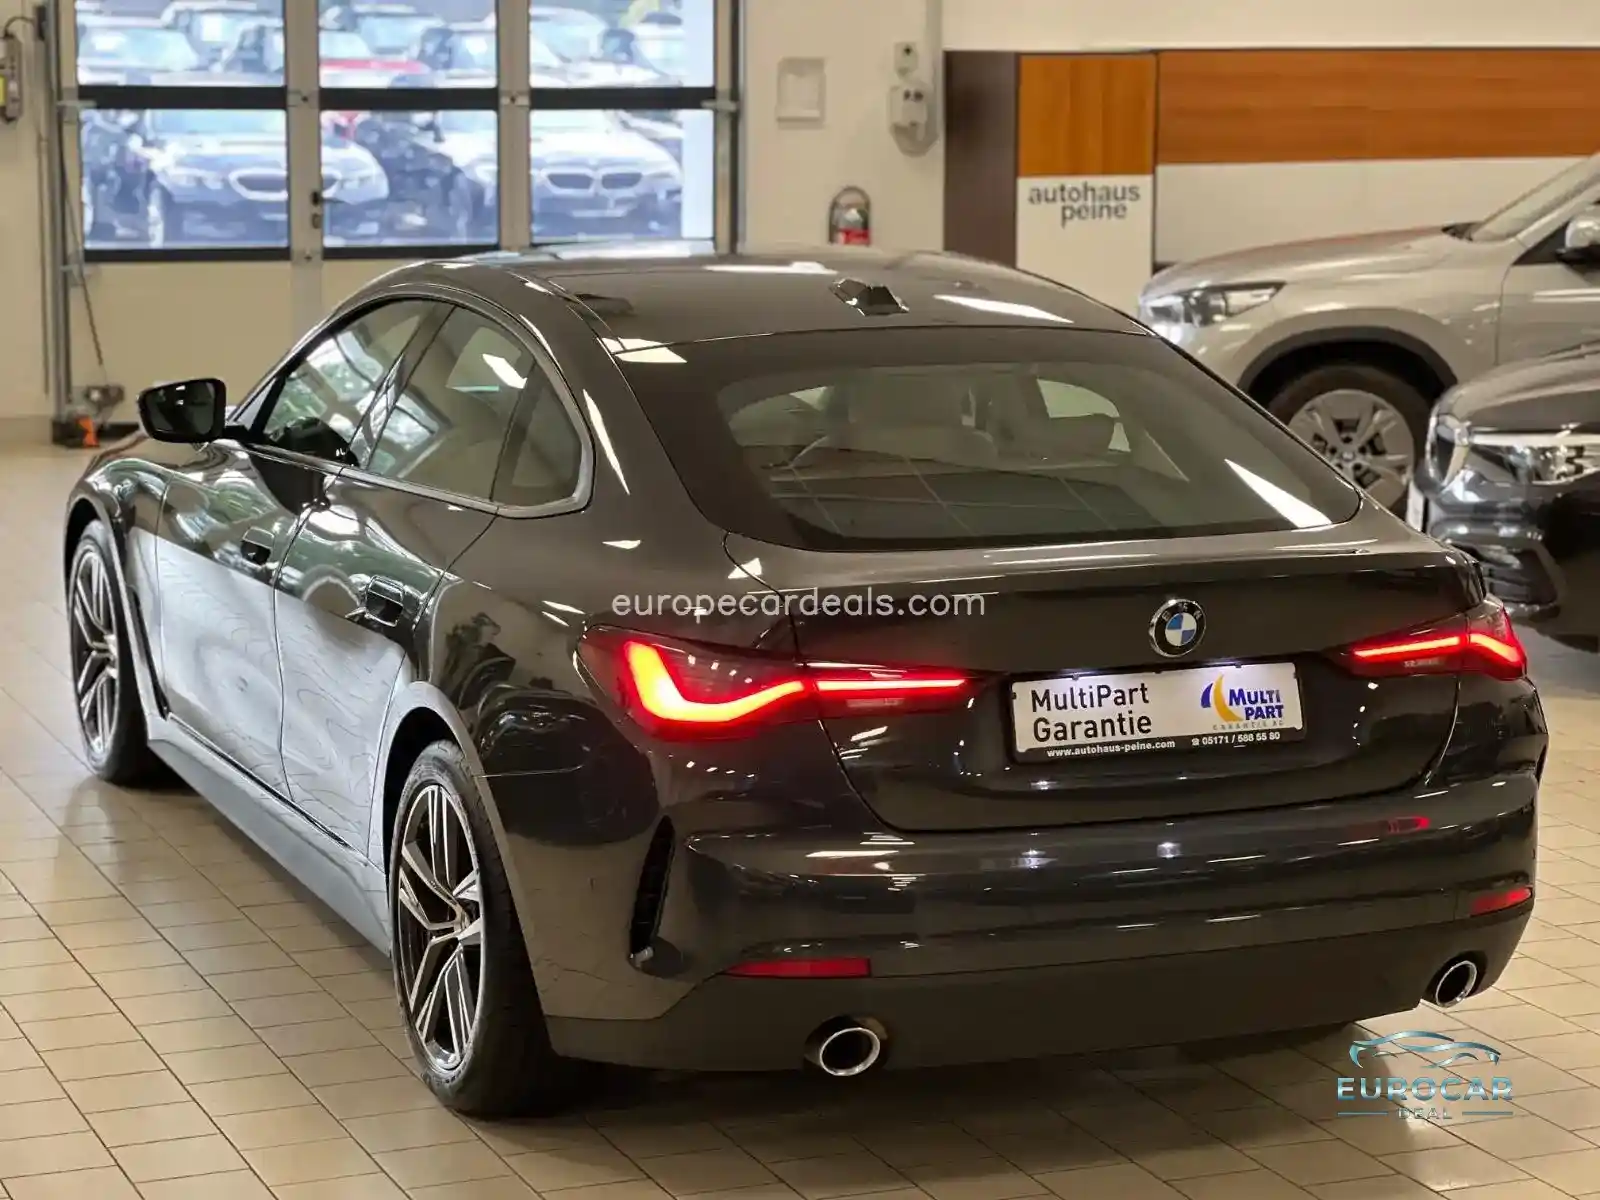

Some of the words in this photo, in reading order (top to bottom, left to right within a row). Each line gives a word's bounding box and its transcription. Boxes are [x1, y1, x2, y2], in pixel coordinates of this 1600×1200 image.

[1028, 181, 1140, 205] autohaus
[1061, 203, 1127, 229] peine
[1031, 682, 1150, 713] MultiPart
[1244, 704, 1285, 721] PART
[1033, 710, 1152, 742] Garantie
[1046, 739, 1176, 757] www.autohaus-peine.com
[1202, 735, 1229, 745] 05171
